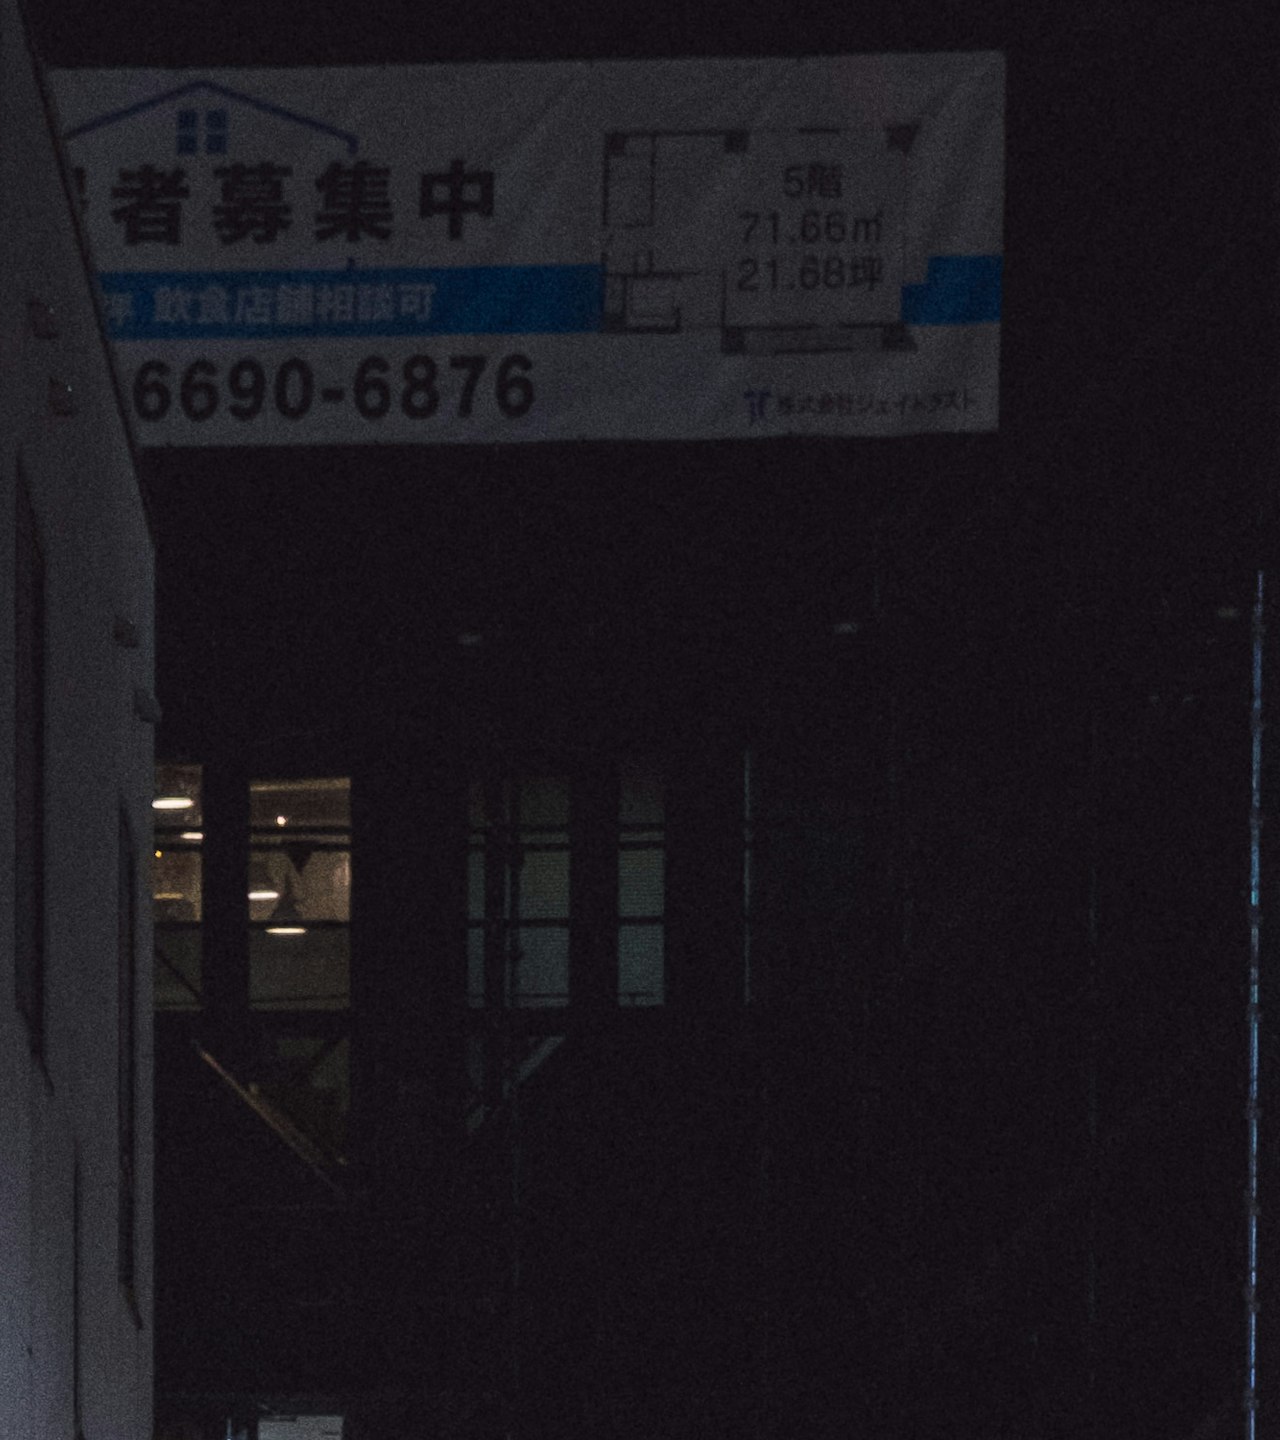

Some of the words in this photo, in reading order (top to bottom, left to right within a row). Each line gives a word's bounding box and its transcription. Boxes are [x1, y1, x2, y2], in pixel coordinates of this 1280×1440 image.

[74, 159, 496, 246] 者募集中
[132, 354, 536, 422] 6690-6876
